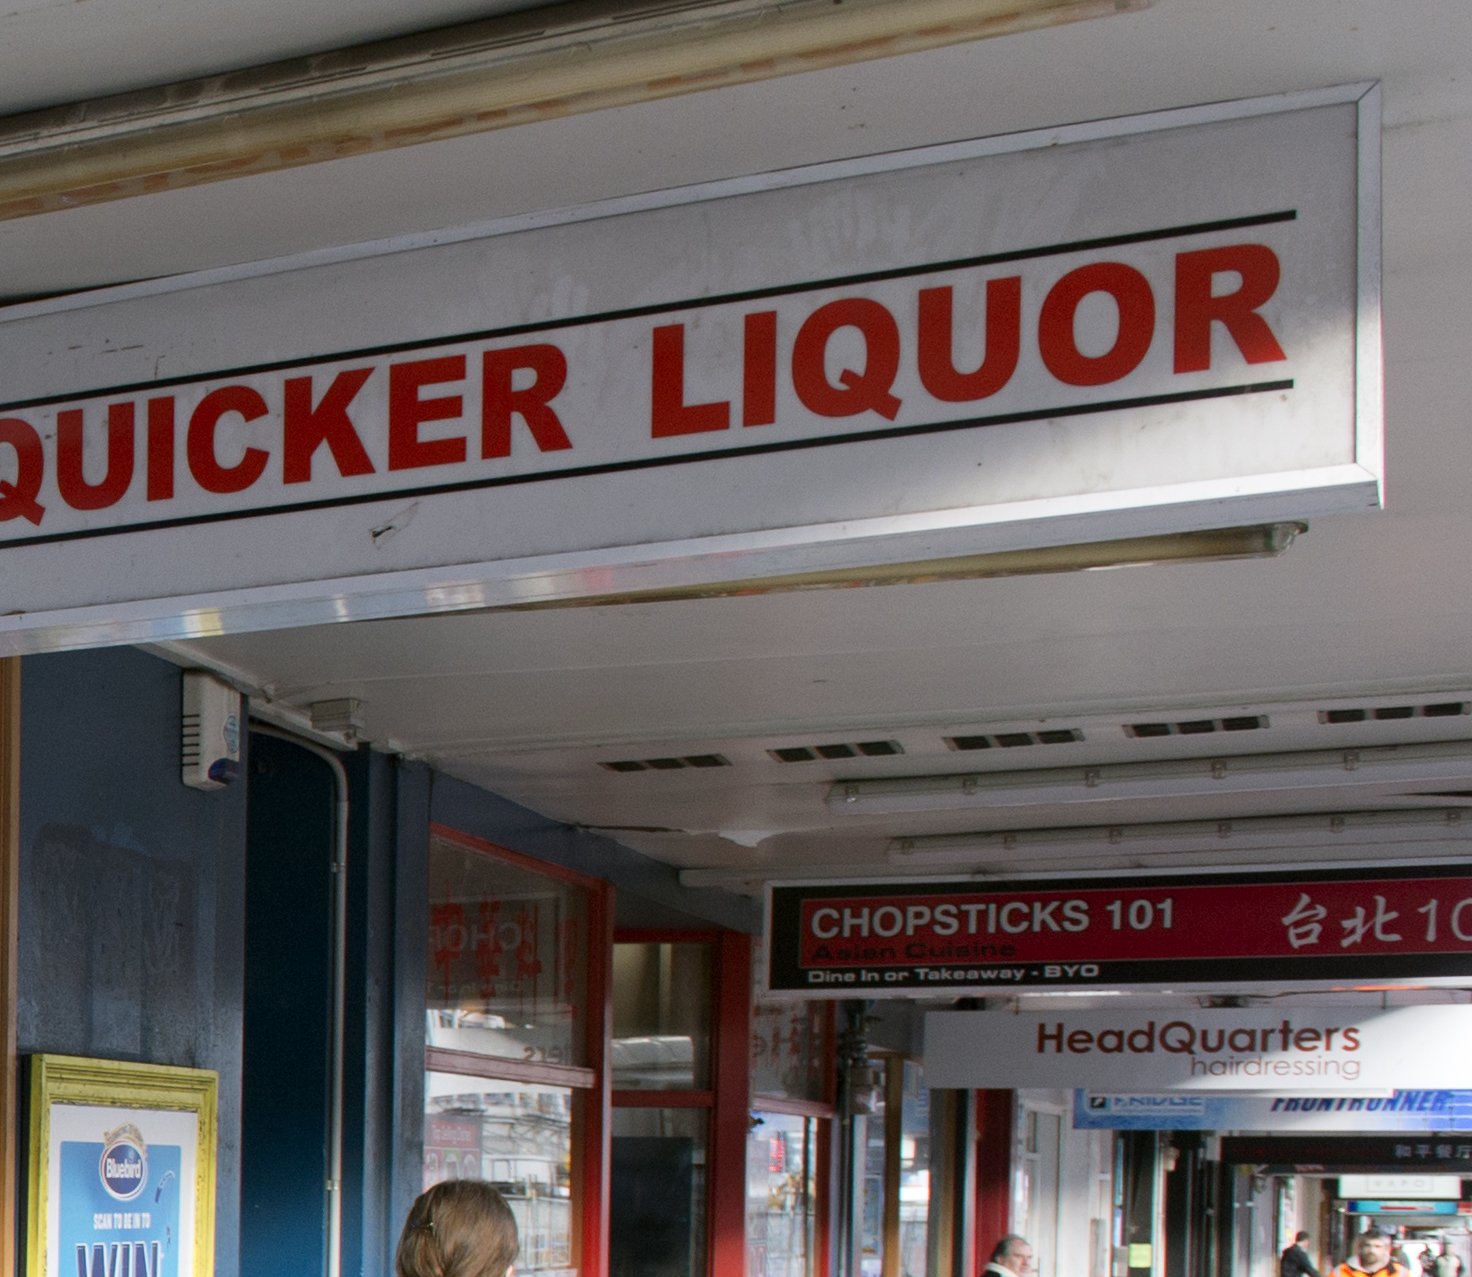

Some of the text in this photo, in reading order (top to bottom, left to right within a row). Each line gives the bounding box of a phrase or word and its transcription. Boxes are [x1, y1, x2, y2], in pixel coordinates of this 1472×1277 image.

[651, 242, 1288, 439] LIQUOR
[811, 898, 1173, 940] CHOPSTICKS 101
[811, 942, 1017, 961] Asian Cuisine
[808, 964, 1099, 983] Dine In or Takeaway BYO
[1037, 1019, 1361, 1055] HeadQuarters
[1191, 1056, 1361, 1080] hairdressing
[105, 1158, 142, 1179] Bluebird
[93, 1213, 112, 1230] SCAN
[113, 1213, 122, 1230] TO
[142, 1212, 151, 1229] TO
